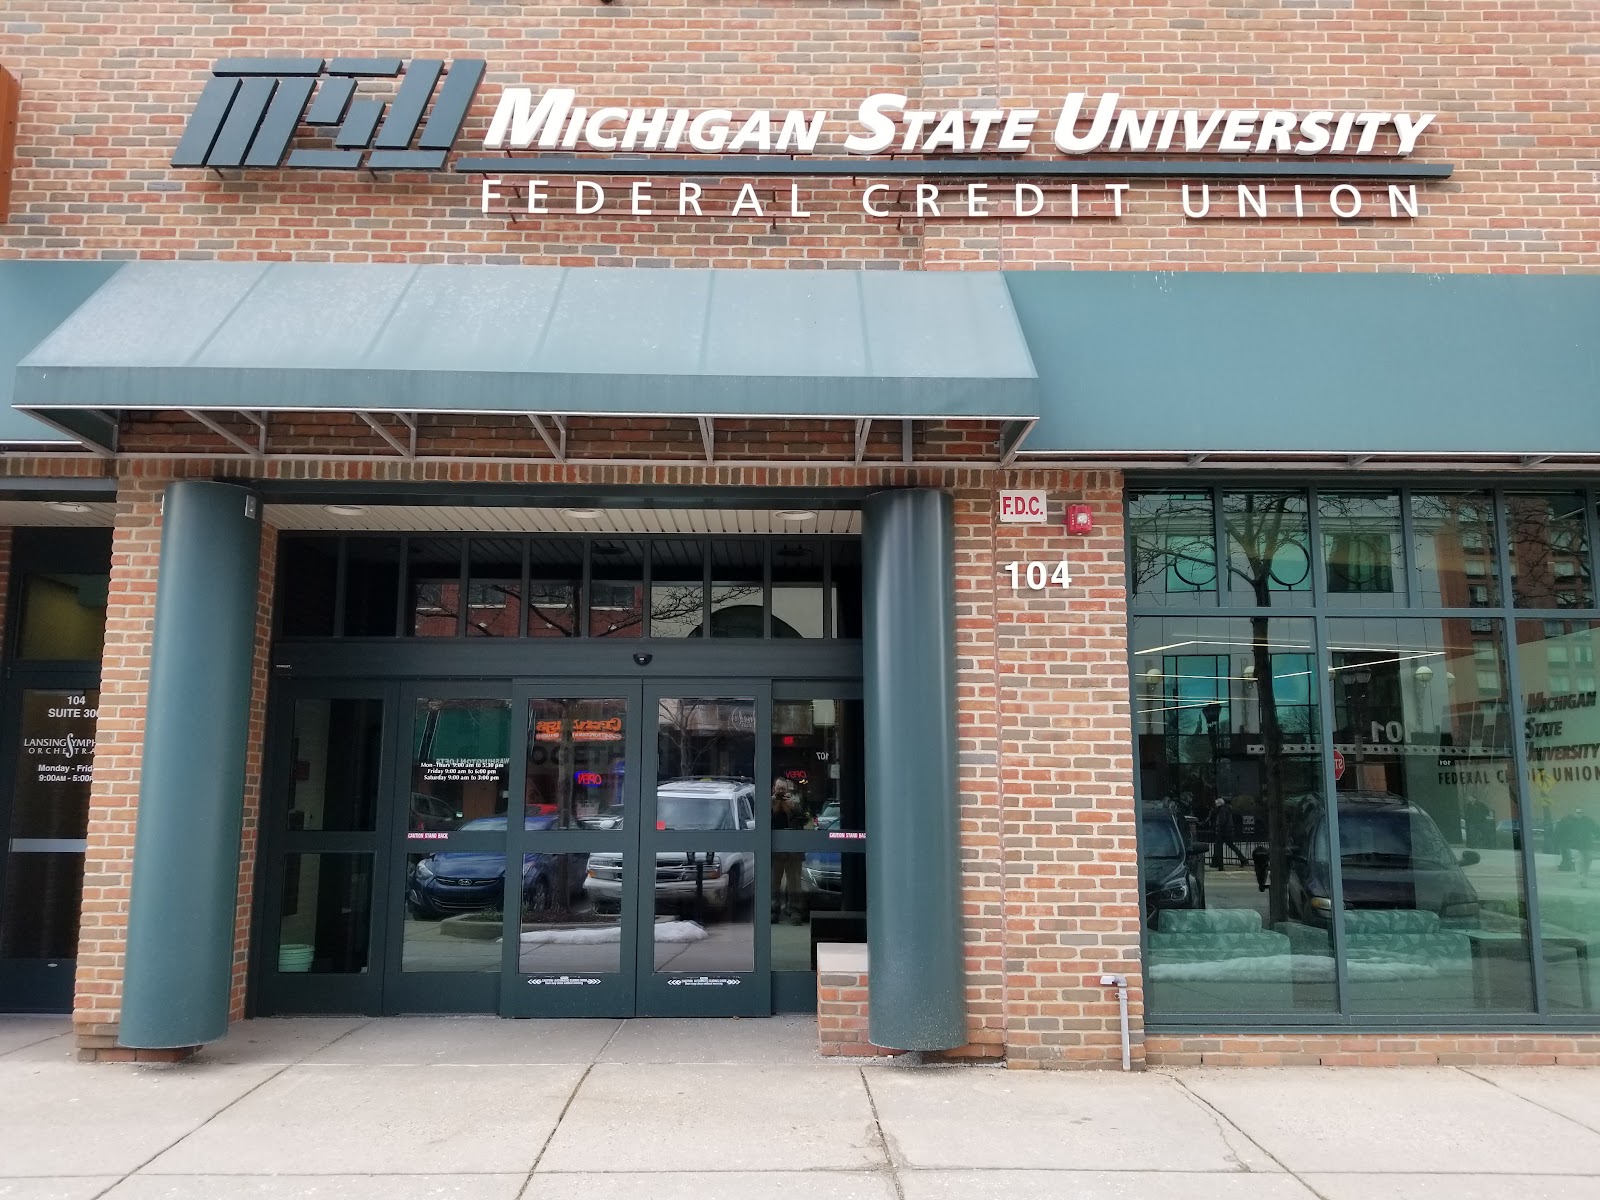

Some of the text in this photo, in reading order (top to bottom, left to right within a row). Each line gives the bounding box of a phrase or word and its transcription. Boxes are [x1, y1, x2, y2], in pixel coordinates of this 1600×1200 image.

[483, 86, 1437, 157] MICHIGAN STATE UNIVERSITY
[480, 177, 1420, 219] FEDERAL CREDIT UNION
[1002, 495, 1044, 516] F.D.C.
[1004, 560, 1073, 591] 104
[67, 695, 86, 705] 104
[47, 708, 81, 718] SUITE
[1525, 717, 1563, 739] STATE
[24, 738, 67, 747] LANSING
[38, 764, 70, 774] Monday
[39, 774, 66, 782] 9:00AM
